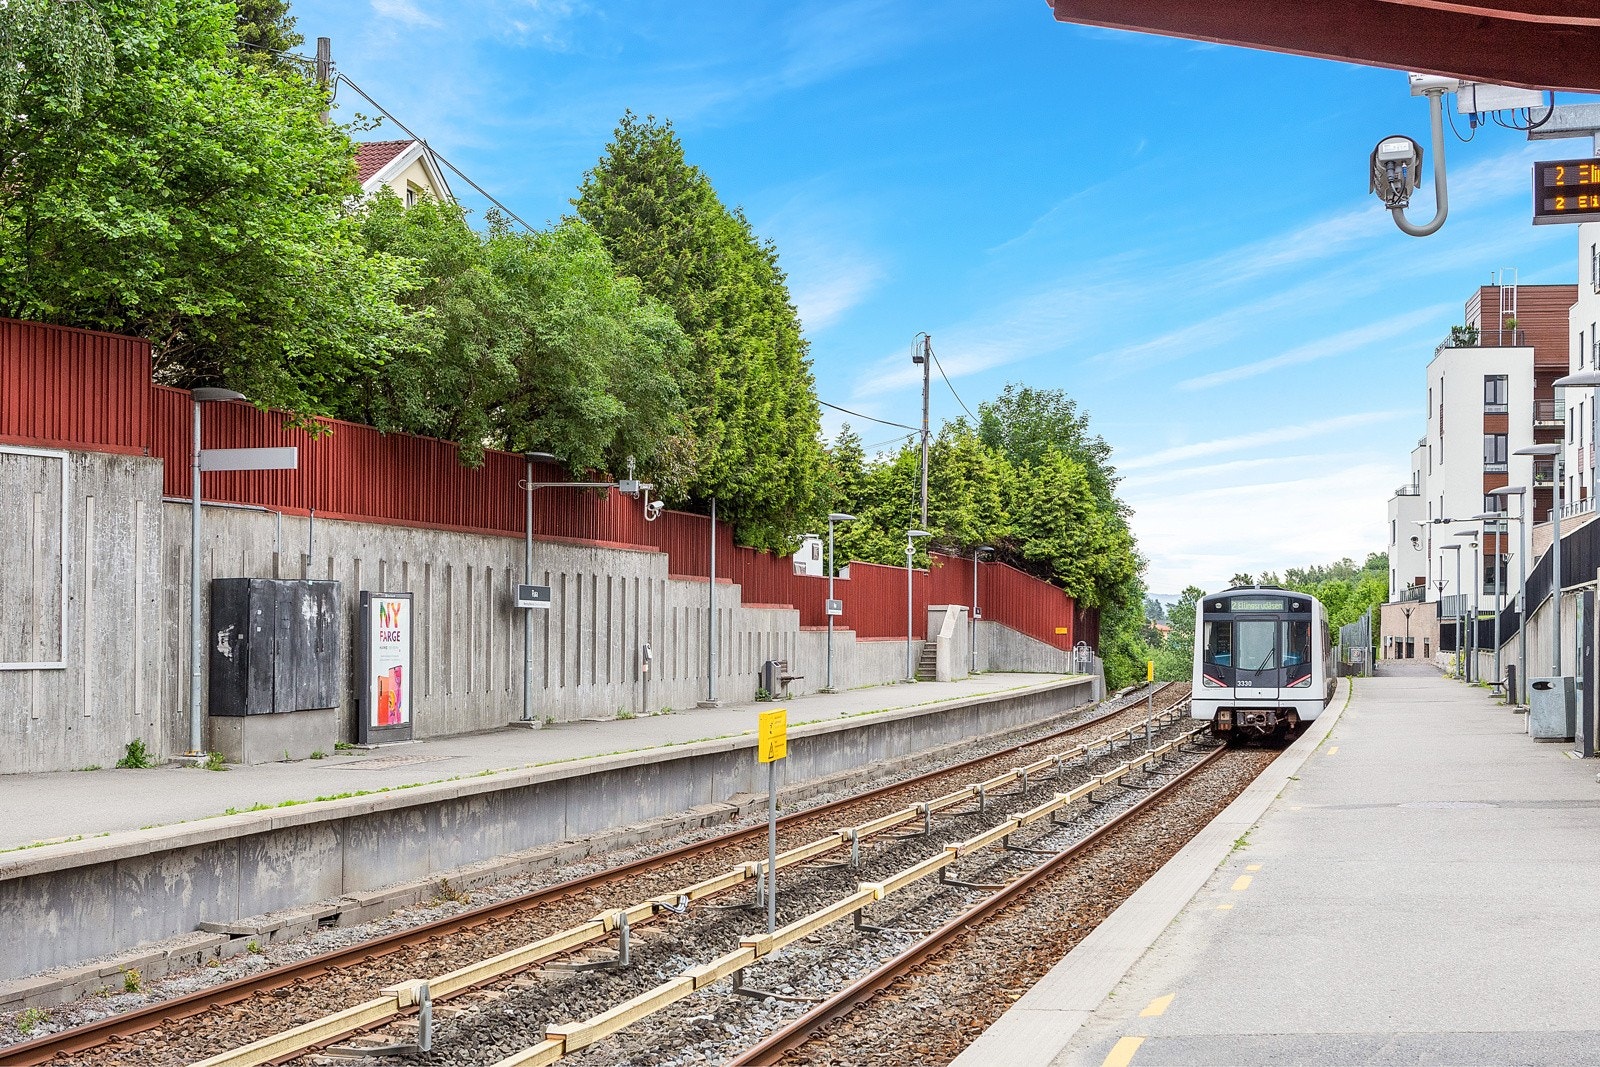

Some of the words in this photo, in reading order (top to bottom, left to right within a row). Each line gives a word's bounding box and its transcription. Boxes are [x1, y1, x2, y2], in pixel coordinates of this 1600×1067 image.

[1556, 166, 1564, 185] 2
[1555, 197, 1565, 210] 2
[379, 601, 401, 629] NY
[379, 630, 401, 643] FARGE
